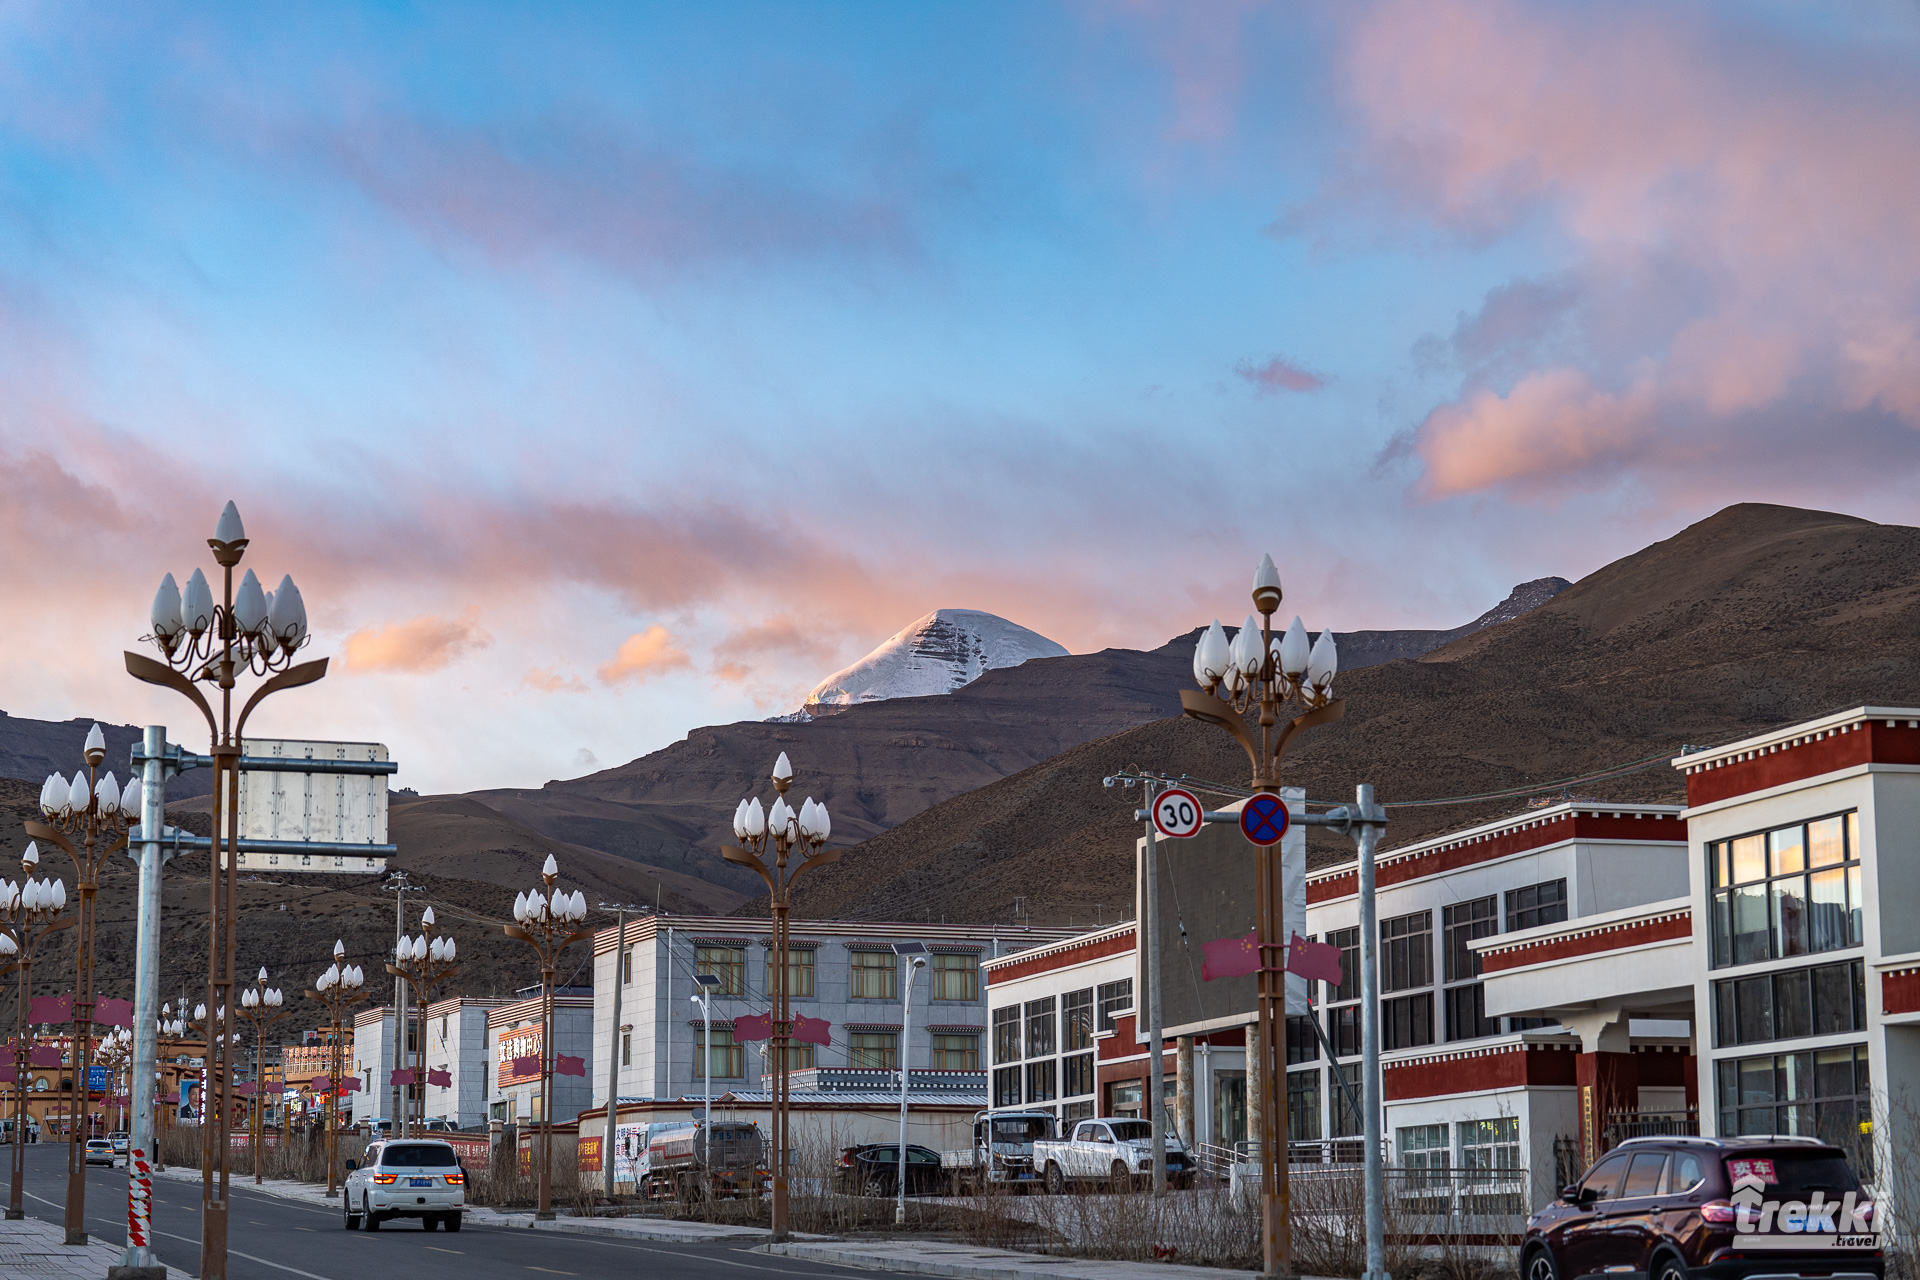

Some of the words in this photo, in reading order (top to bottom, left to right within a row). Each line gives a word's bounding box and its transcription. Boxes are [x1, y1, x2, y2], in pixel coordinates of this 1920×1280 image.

[1163, 802, 1194, 828] 30
[500, 1033, 542, 1062] 优选购物中心
[1733, 1161, 1772, 1176] 卖车
